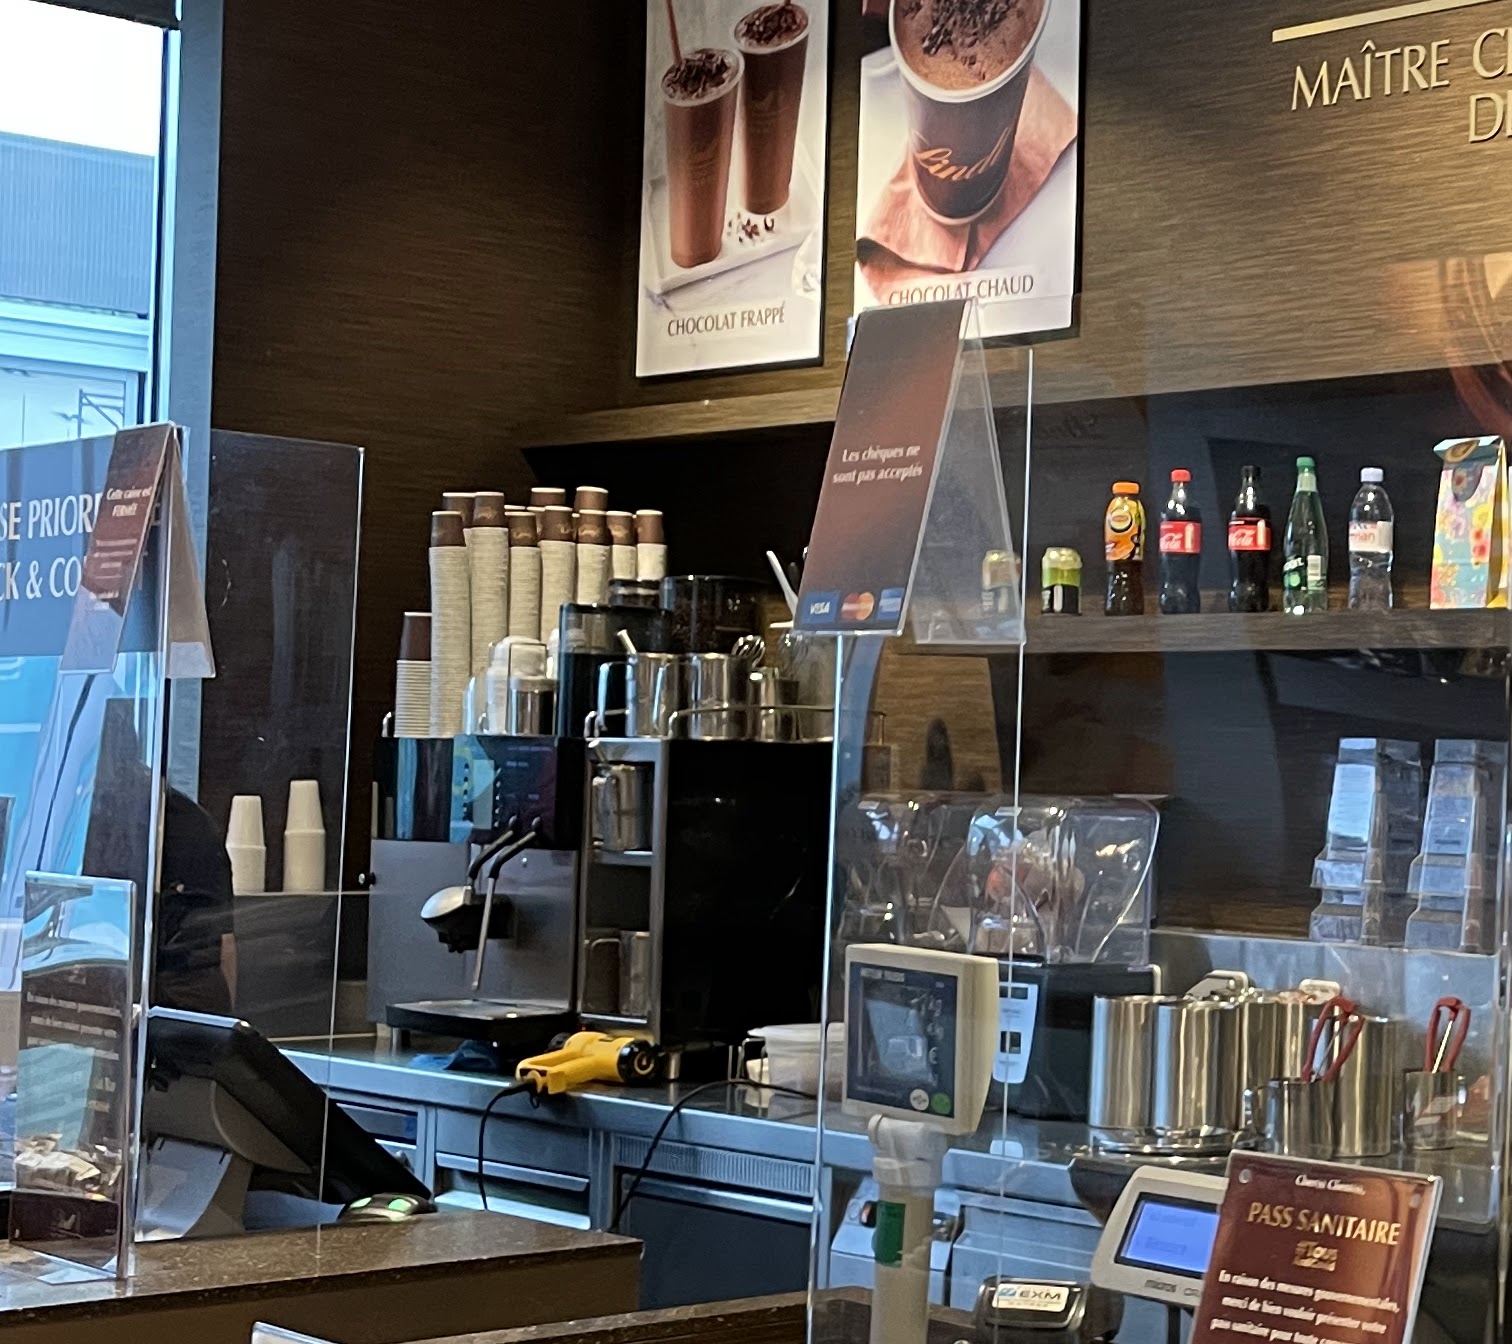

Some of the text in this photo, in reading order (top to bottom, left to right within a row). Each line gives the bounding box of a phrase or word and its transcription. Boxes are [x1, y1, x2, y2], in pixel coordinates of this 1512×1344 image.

[1290, 36, 1450, 111] MAÎTRE
[888, 274, 1034, 305] CHOCOLAT CHAUD
[667, 301, 785, 337] CHOCOLAT FRAPPÉ
[842, 445, 921, 463] Les chèques ne
[832, 462, 923, 486] sont pas acceptés
[26, 560, 43, 599] &
[1248, 1202, 1401, 1246] PASS SANITAIRE
